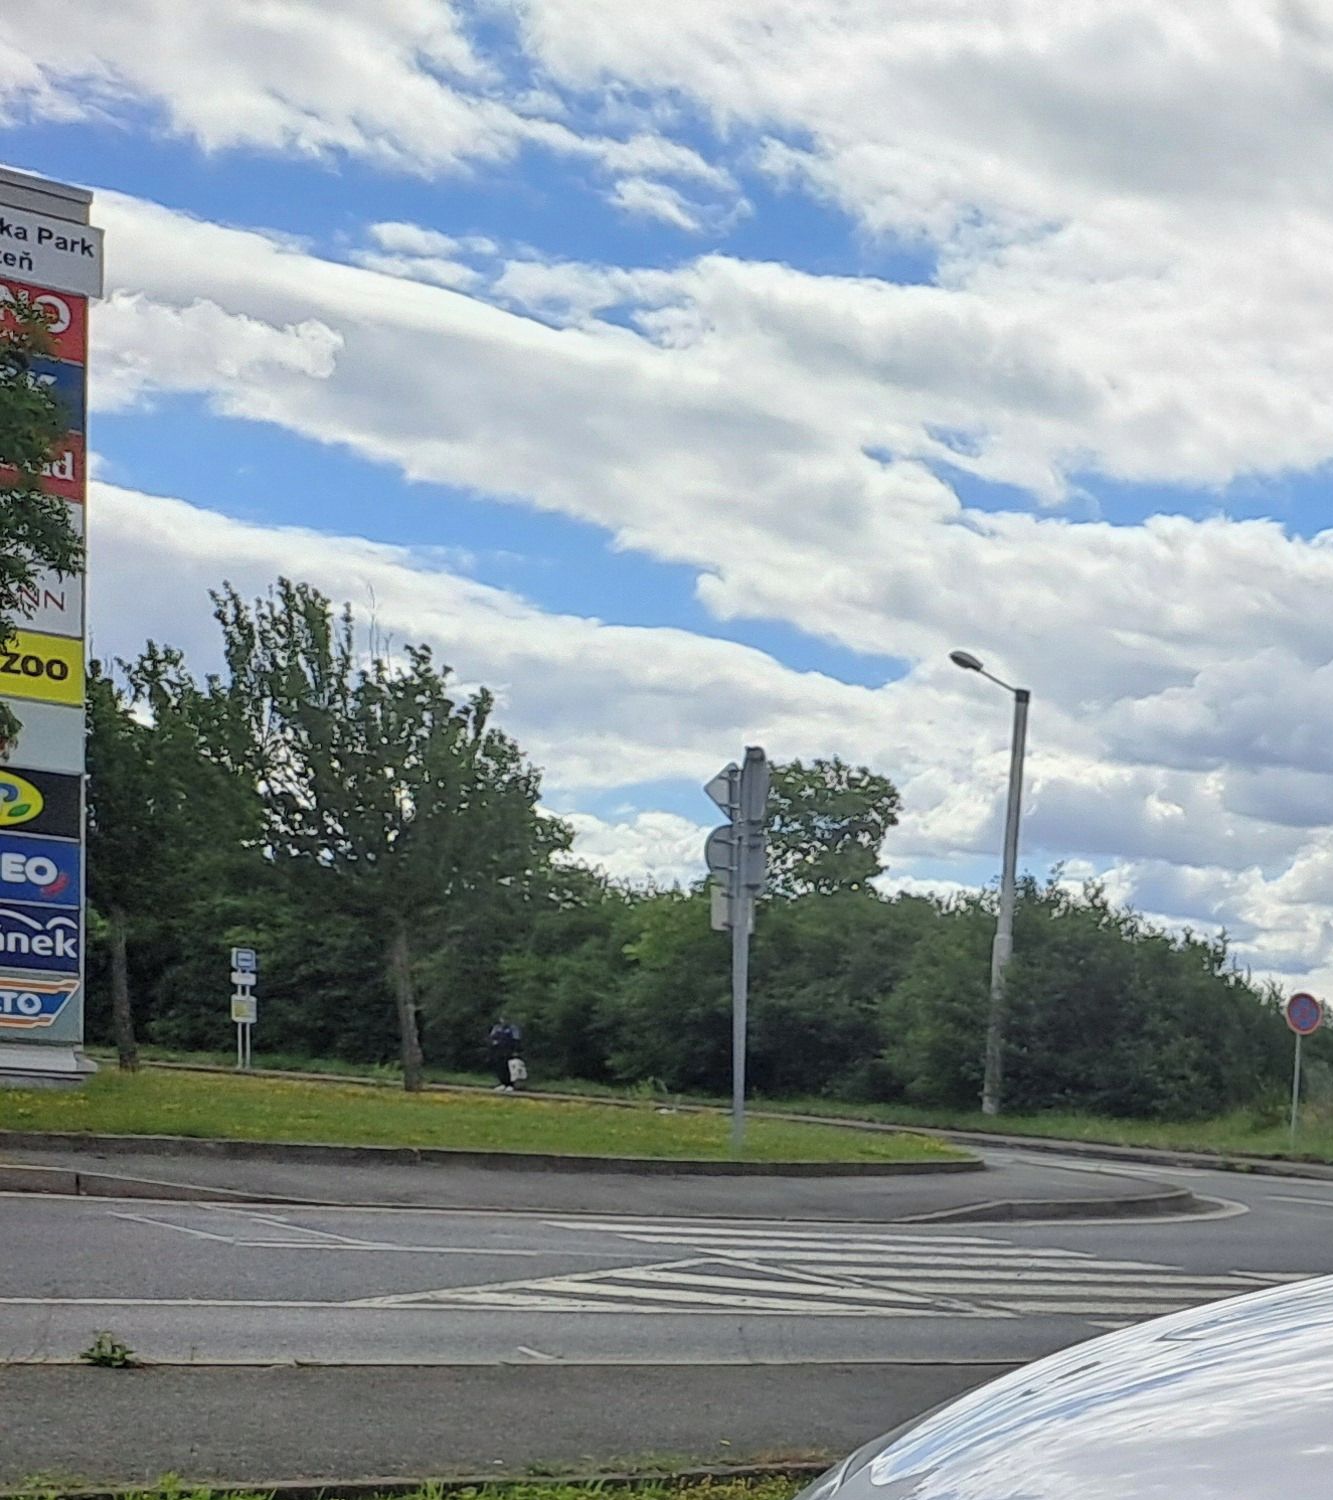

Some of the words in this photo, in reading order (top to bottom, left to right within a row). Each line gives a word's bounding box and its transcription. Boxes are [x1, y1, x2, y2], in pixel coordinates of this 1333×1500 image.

[37, 226, 95, 259] Park
[0, 250, 33, 271] eň
[1, 851, 59, 886] EO
[0, 991, 42, 1015] TO
